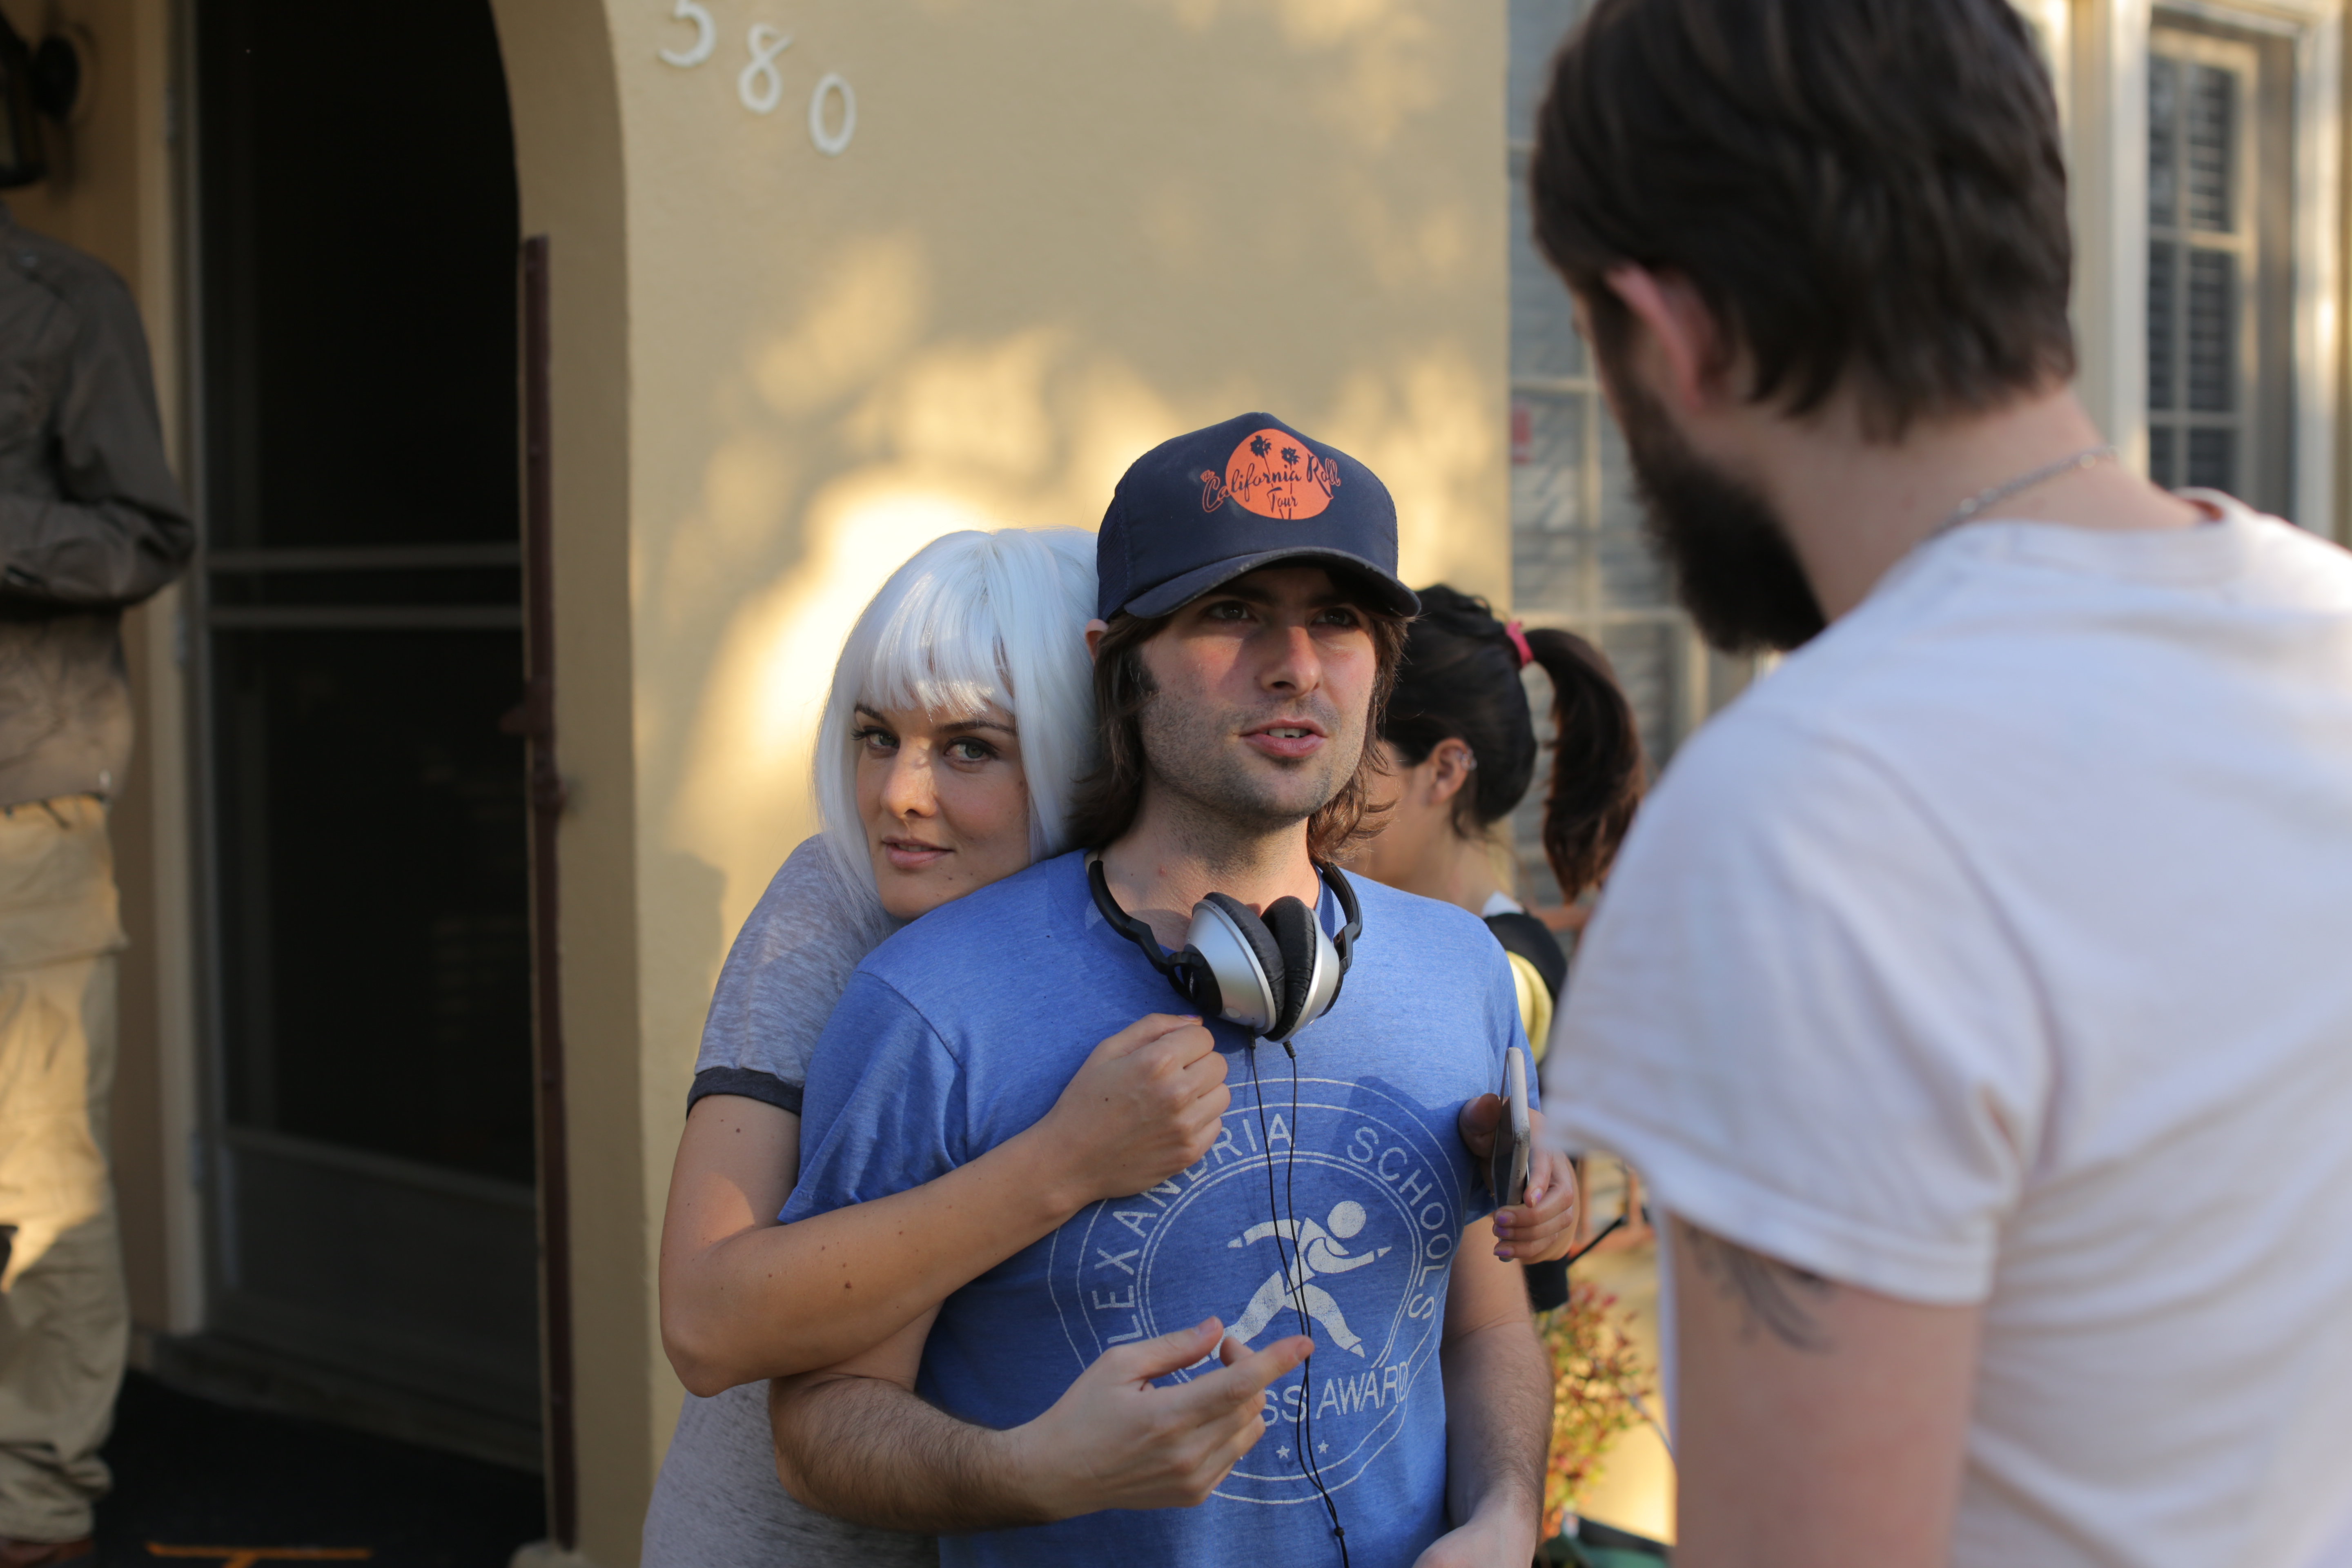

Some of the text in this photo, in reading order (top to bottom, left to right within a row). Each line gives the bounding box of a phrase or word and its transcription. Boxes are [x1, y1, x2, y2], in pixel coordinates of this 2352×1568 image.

[657, 0, 858, 157] 580
[1202, 453, 1341, 513] California Roll
[1266, 486, 1298, 513] Tour
[1091, 1113, 1452, 1344] LEXANDRIA SCHOOLS
[1316, 1361, 1408, 1419] AWARD
